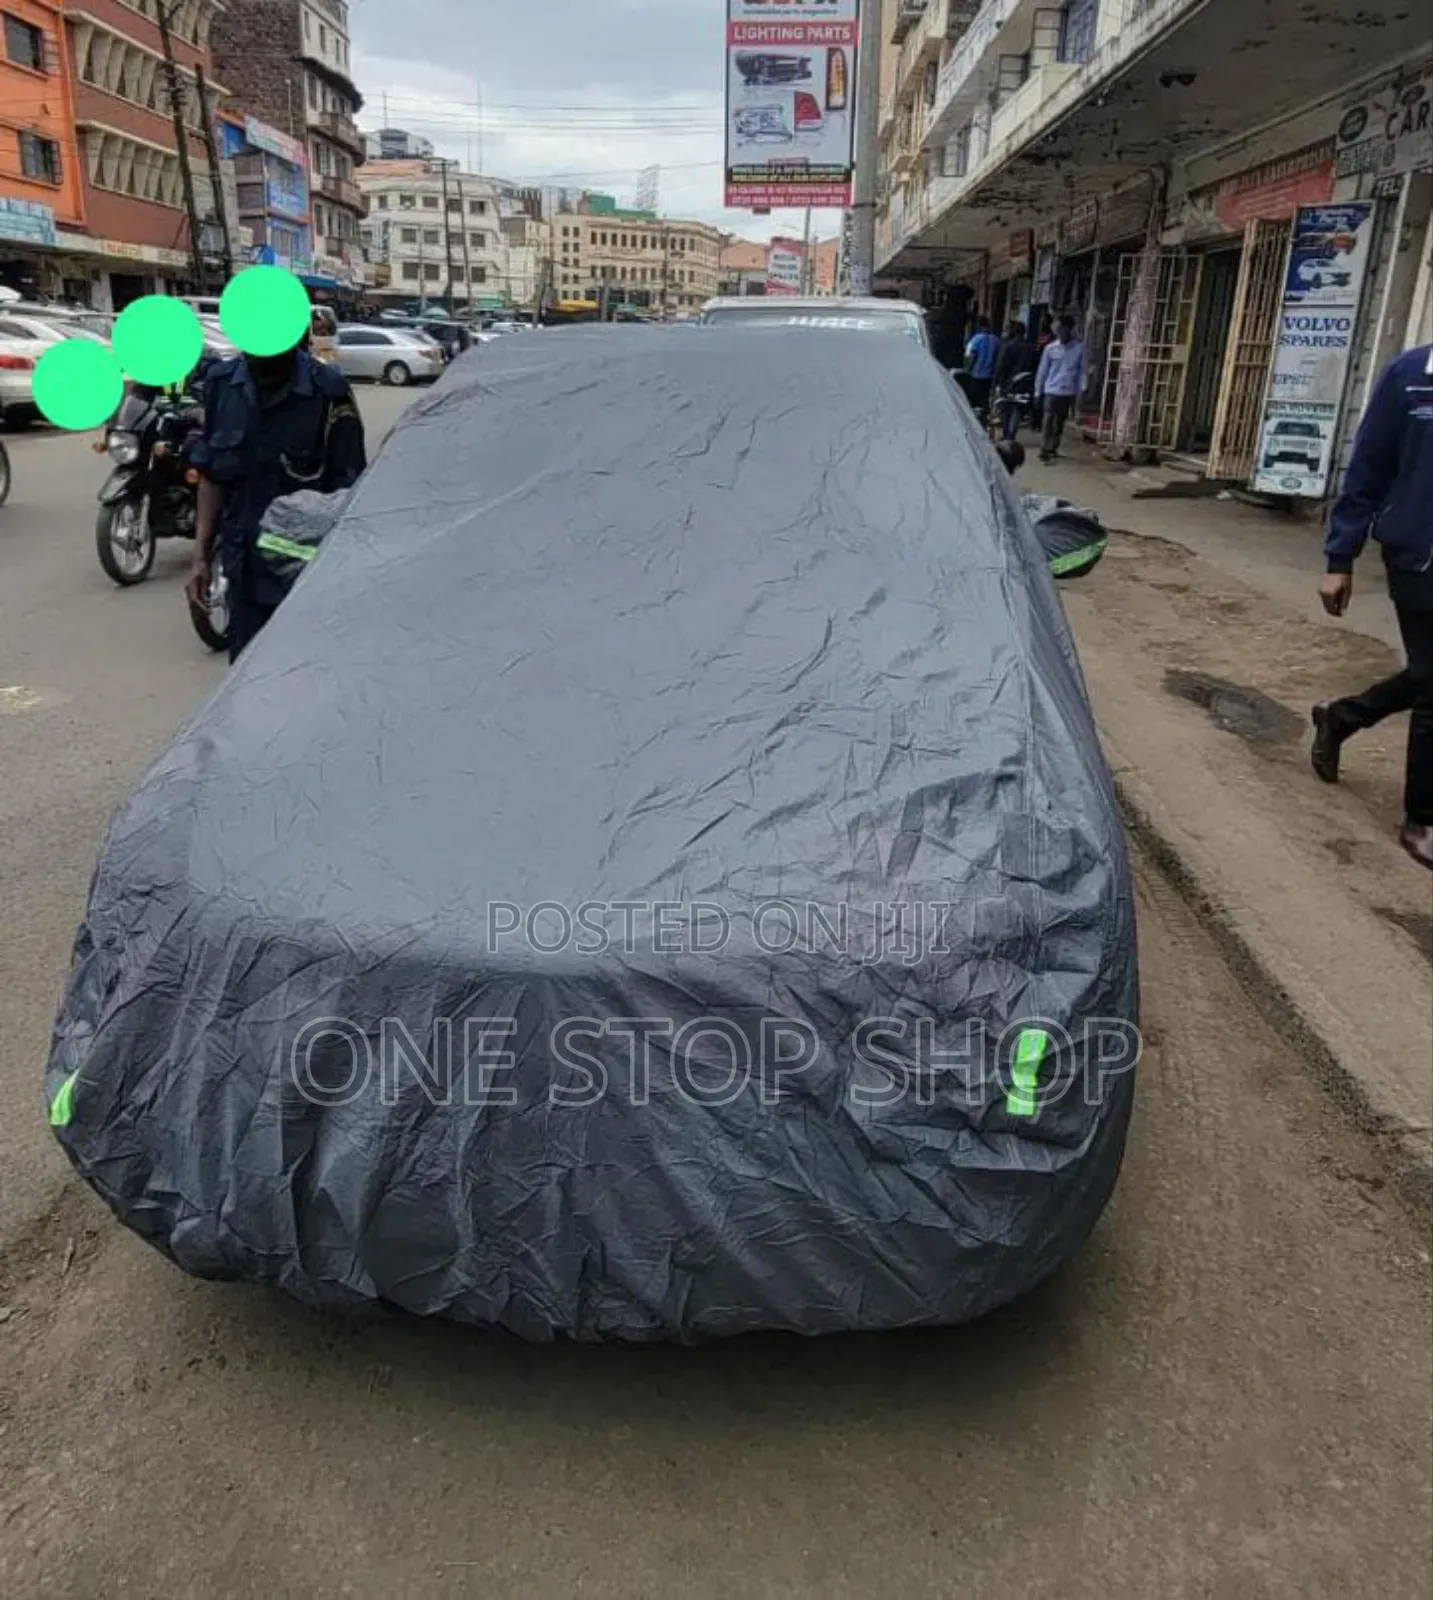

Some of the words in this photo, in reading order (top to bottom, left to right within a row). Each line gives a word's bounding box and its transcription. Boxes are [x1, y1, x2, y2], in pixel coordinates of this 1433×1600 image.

[734, 26, 804, 40] LIGHTING
[807, 26, 851, 40] PARTS
[1284, 316, 1350, 331] VOLVO
[1279, 334, 1348, 348] SPARES
